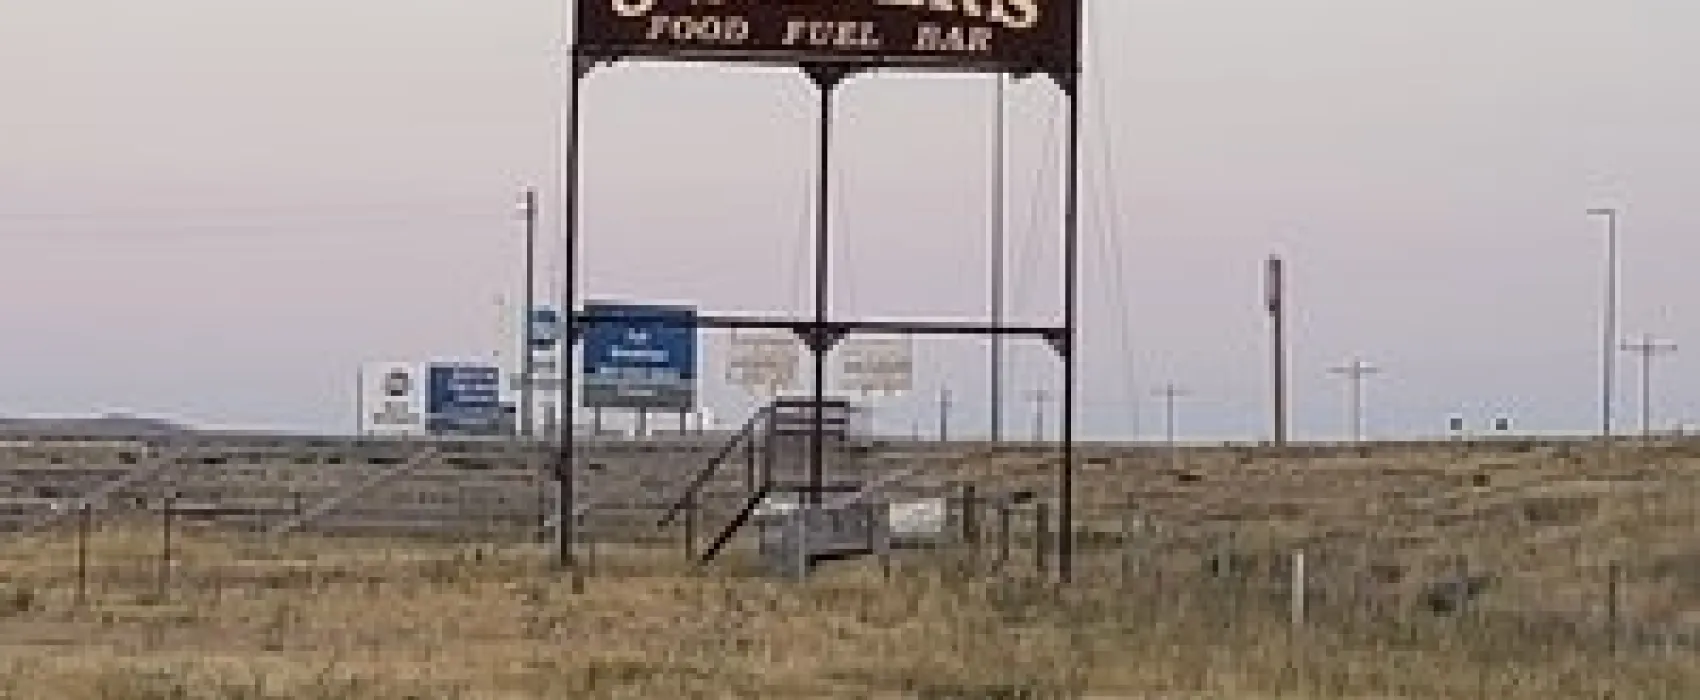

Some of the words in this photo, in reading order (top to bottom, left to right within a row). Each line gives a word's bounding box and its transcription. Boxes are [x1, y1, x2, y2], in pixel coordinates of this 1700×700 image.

[646, 15, 748, 44] FOOD
[782, 19, 879, 50] FUEL
[913, 25, 992, 52] BAR
